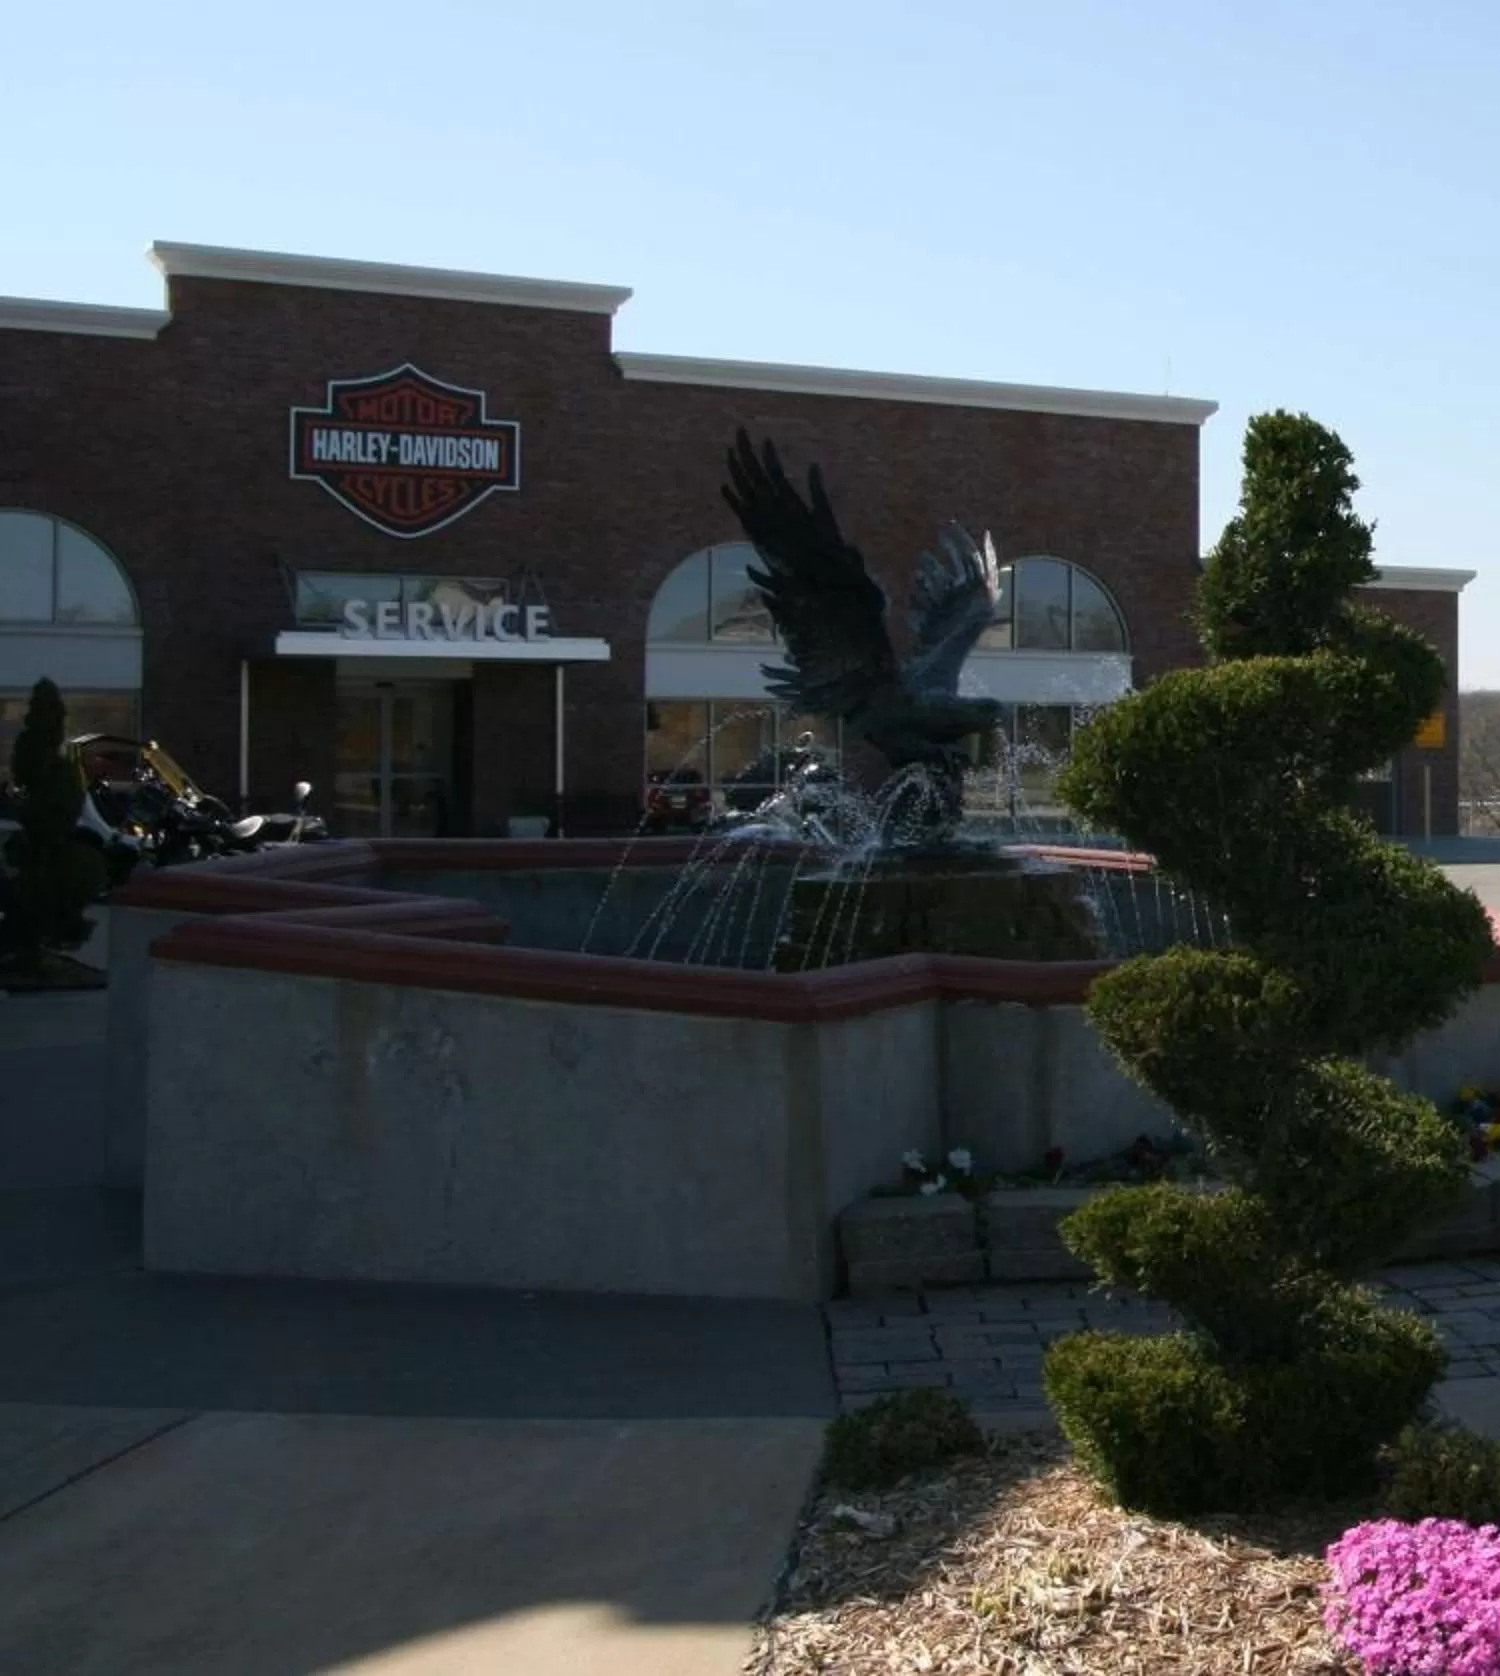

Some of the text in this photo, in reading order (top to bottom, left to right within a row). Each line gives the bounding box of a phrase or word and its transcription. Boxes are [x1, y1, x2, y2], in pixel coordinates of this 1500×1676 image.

[357, 391, 459, 425] MOTOR
[312, 428, 499, 472] HARLEY-DAVIDSON
[356, 474, 455, 514] CYCLES
[341, 600, 552, 642] SERVICE
